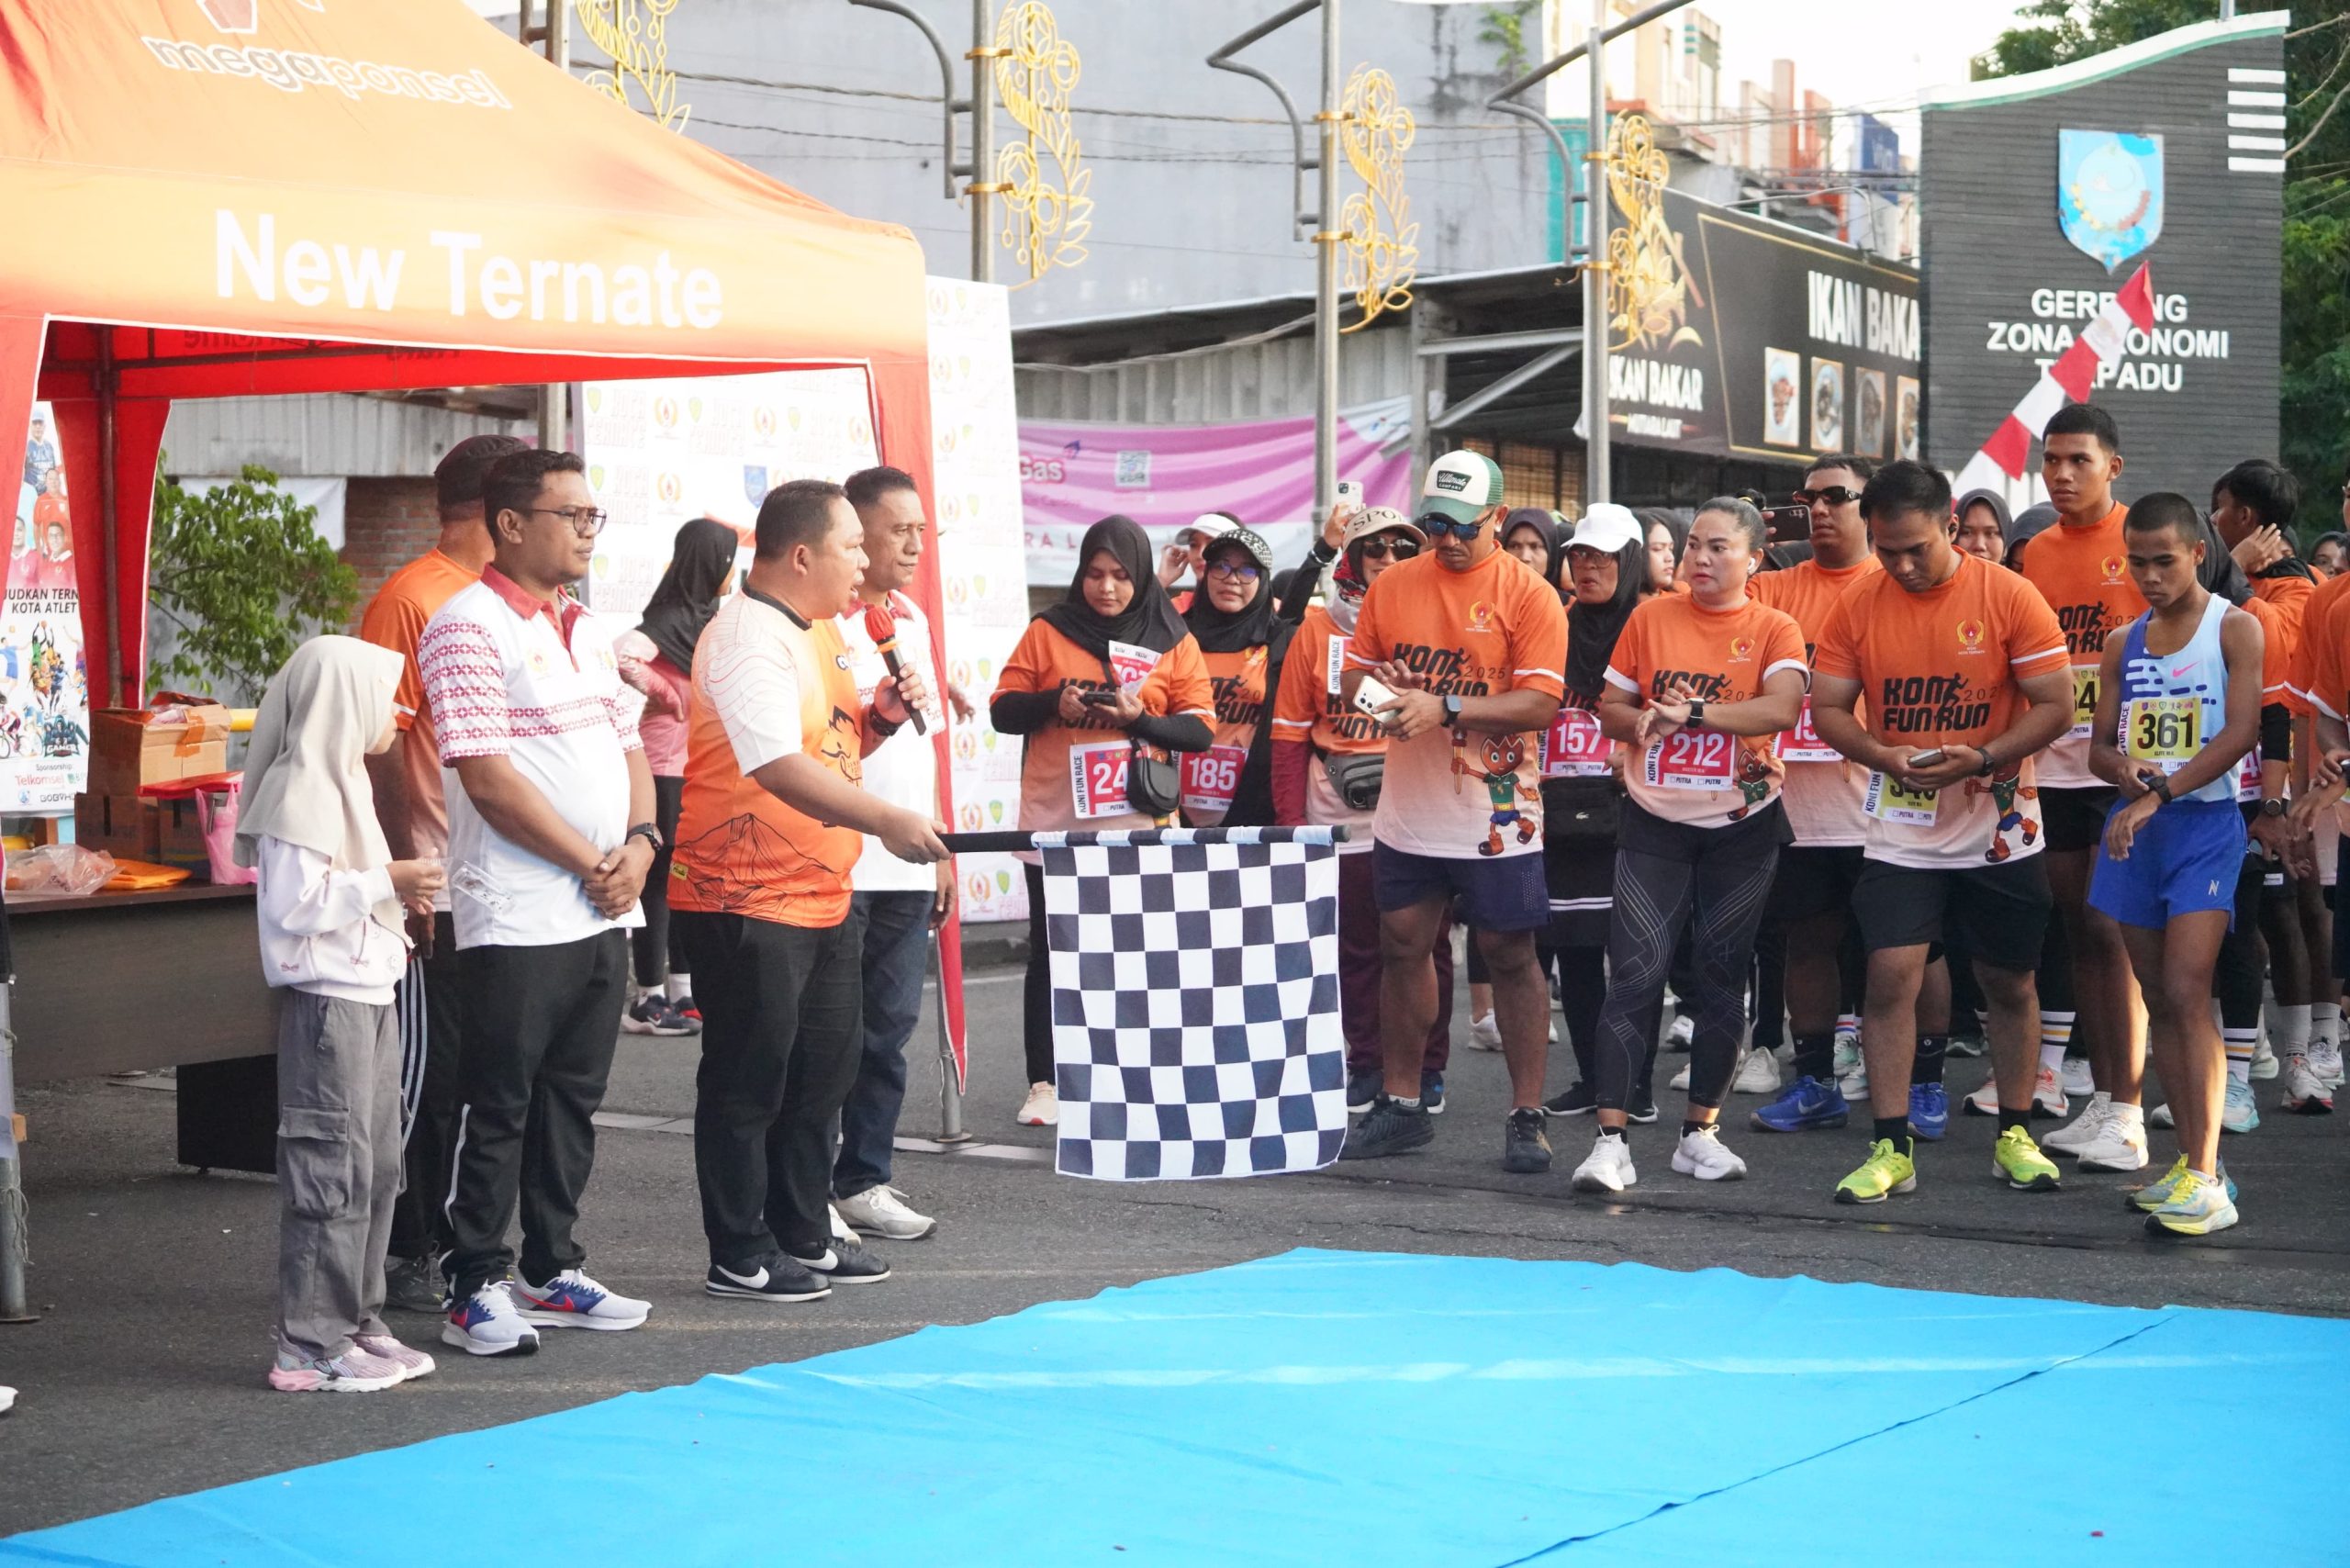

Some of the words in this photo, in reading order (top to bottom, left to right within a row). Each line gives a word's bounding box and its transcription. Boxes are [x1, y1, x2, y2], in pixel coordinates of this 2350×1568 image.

[140, 36, 512, 109] megaponsel
[215, 208, 406, 312] New
[430, 230, 723, 330] Ternate
[1808, 270, 1862, 349] IKAN
[1866, 286, 1920, 362] BAKA
[2031, 288, 2188, 322] GERNG
[1986, 322, 2075, 353] ZONA
[2119, 327, 2229, 358] ONOMI
[1649, 360, 1703, 411] BAKAR
[2034, 358, 2183, 392] TPADU
[1020, 454, 1063, 482] Gas
[1438, 472, 1467, 487] Ultimate
[1353, 509, 1403, 532] SPO
[12, 602, 41, 613] KOTA
[45, 602, 77, 613] ATLET
[1461, 665, 1506, 680] 2025
[1883, 706, 1933, 733] FUN
[1934, 702, 1991, 733] RUN
[2120, 706, 2130, 730] RACE
[2137, 711, 2194, 750] 361
[1556, 722, 1602, 754] 157
[1649, 744, 1661, 759] FUN
[1669, 733, 1724, 767] 212
[2120, 730, 2128, 749] FUN
[1073, 755, 1083, 776] RACE
[1188, 756, 1237, 791] 185
[1648, 761, 1656, 781] KONI
[15, 774, 64, 786] Telkomsel
[1075, 778, 1085, 793] FUN
[1864, 792, 1876, 812] KONI
[1870, 773, 1881, 791] FUN
[1077, 794, 1087, 812] KONI
[1898, 811, 1914, 819] PUTRA
